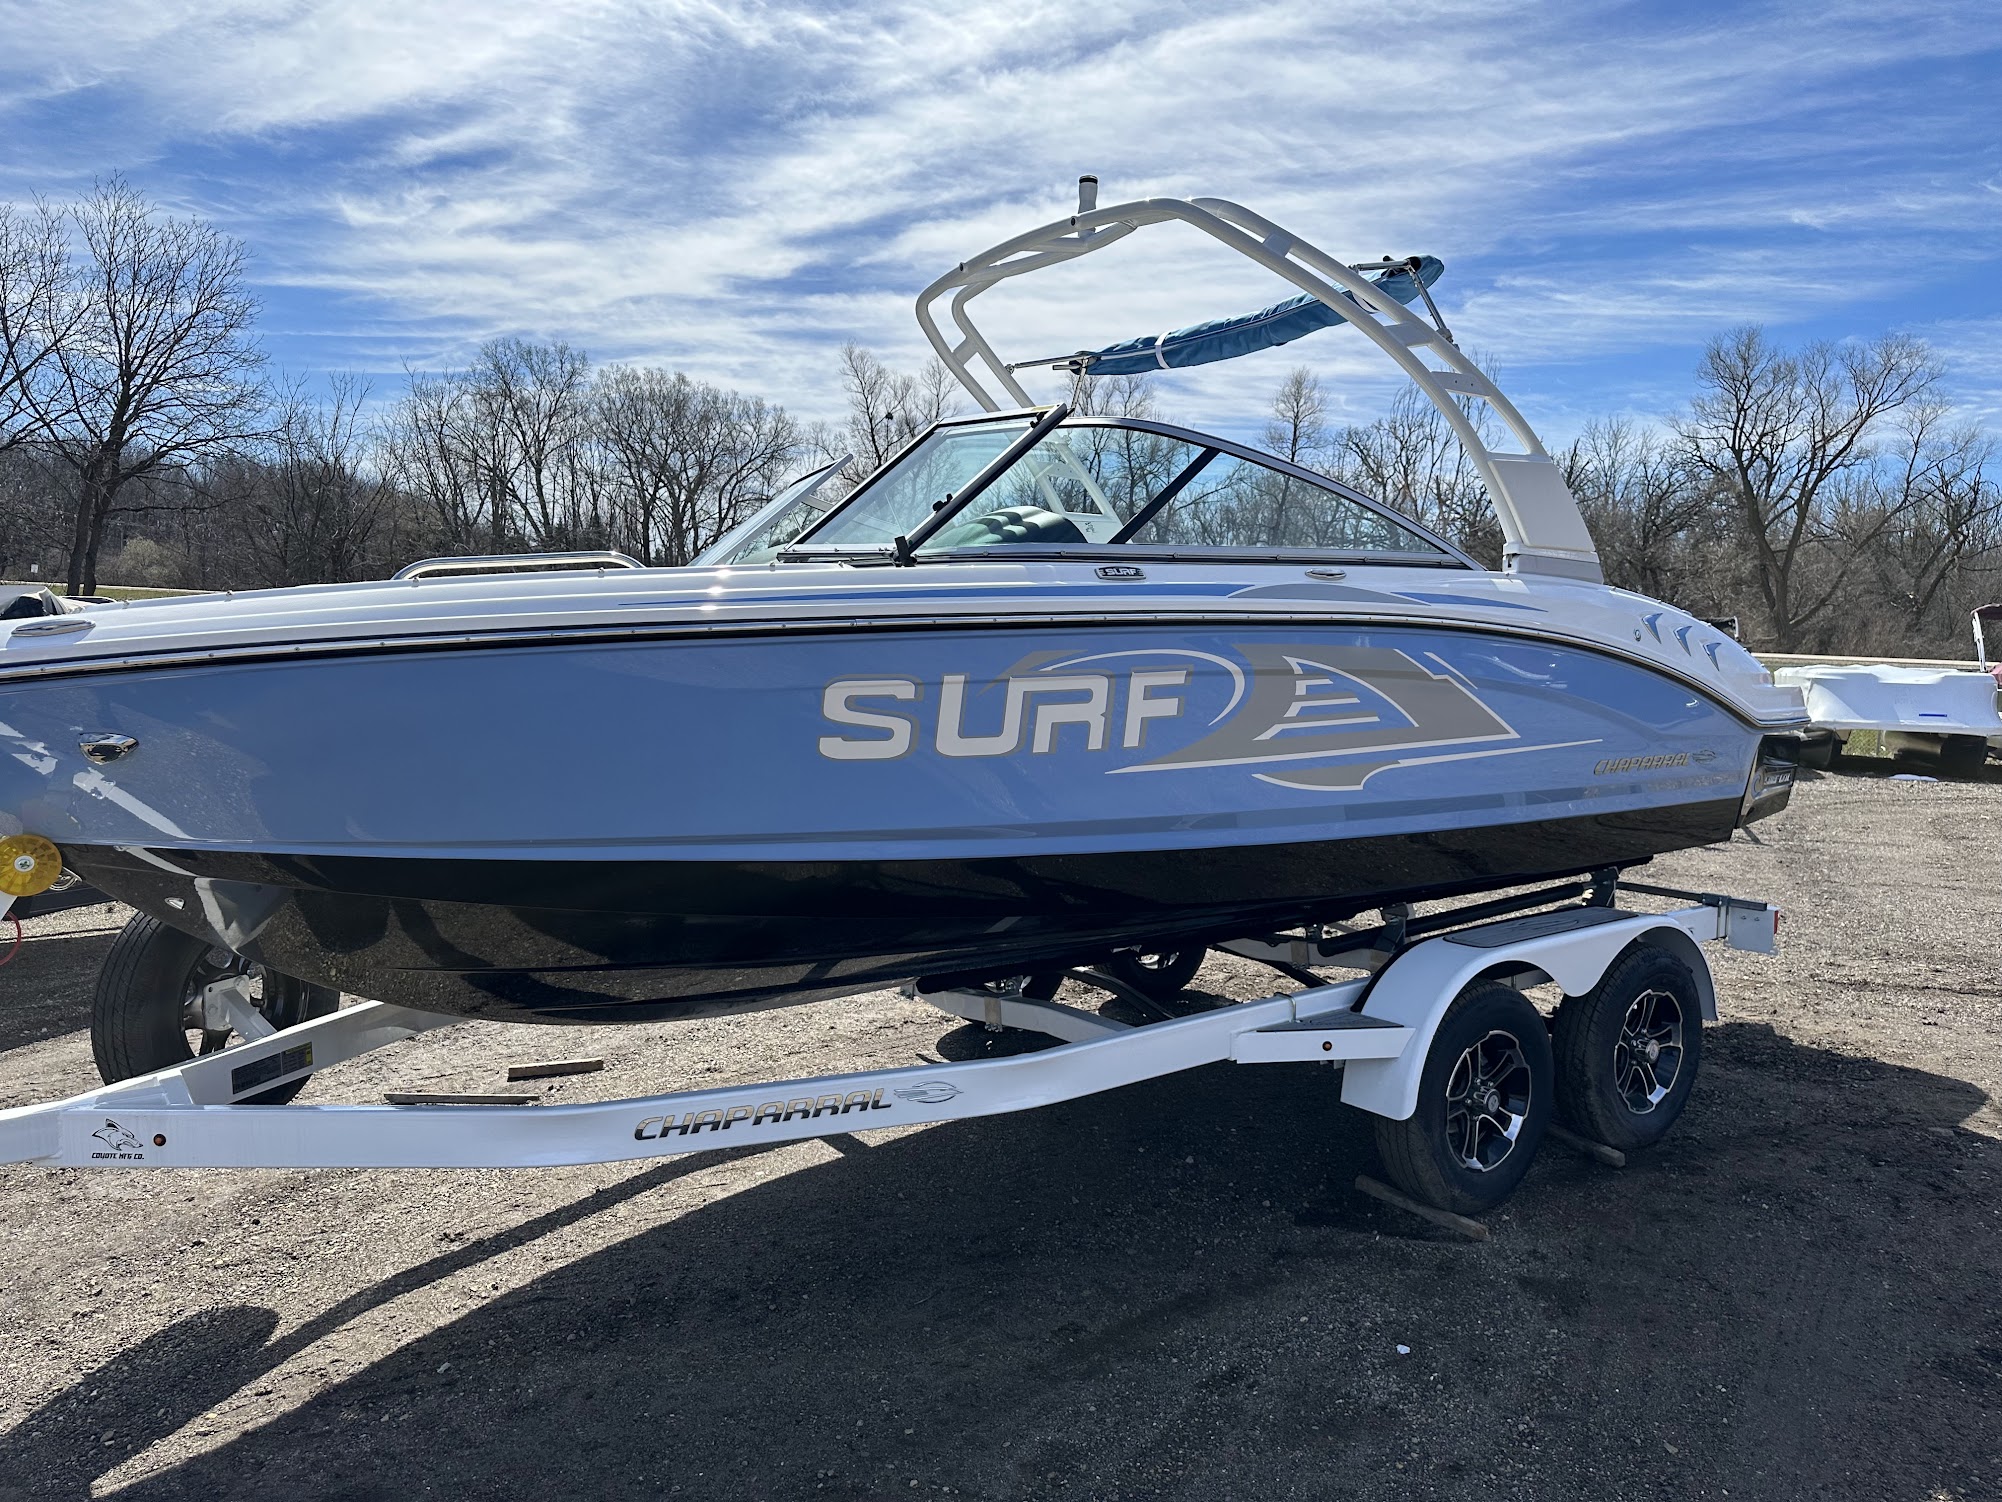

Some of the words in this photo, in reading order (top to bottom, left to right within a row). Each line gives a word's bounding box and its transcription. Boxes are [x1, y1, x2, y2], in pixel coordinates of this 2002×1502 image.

[1105, 568, 1137, 576] SURF
[818, 670, 1189, 760] SURF
[1593, 752, 1690, 775] CHAPARRAL
[634, 1088, 892, 1141] CHAPARRAL
[91, 1152, 118, 1160] COYOTE
[118, 1152, 133, 1160] MFG
